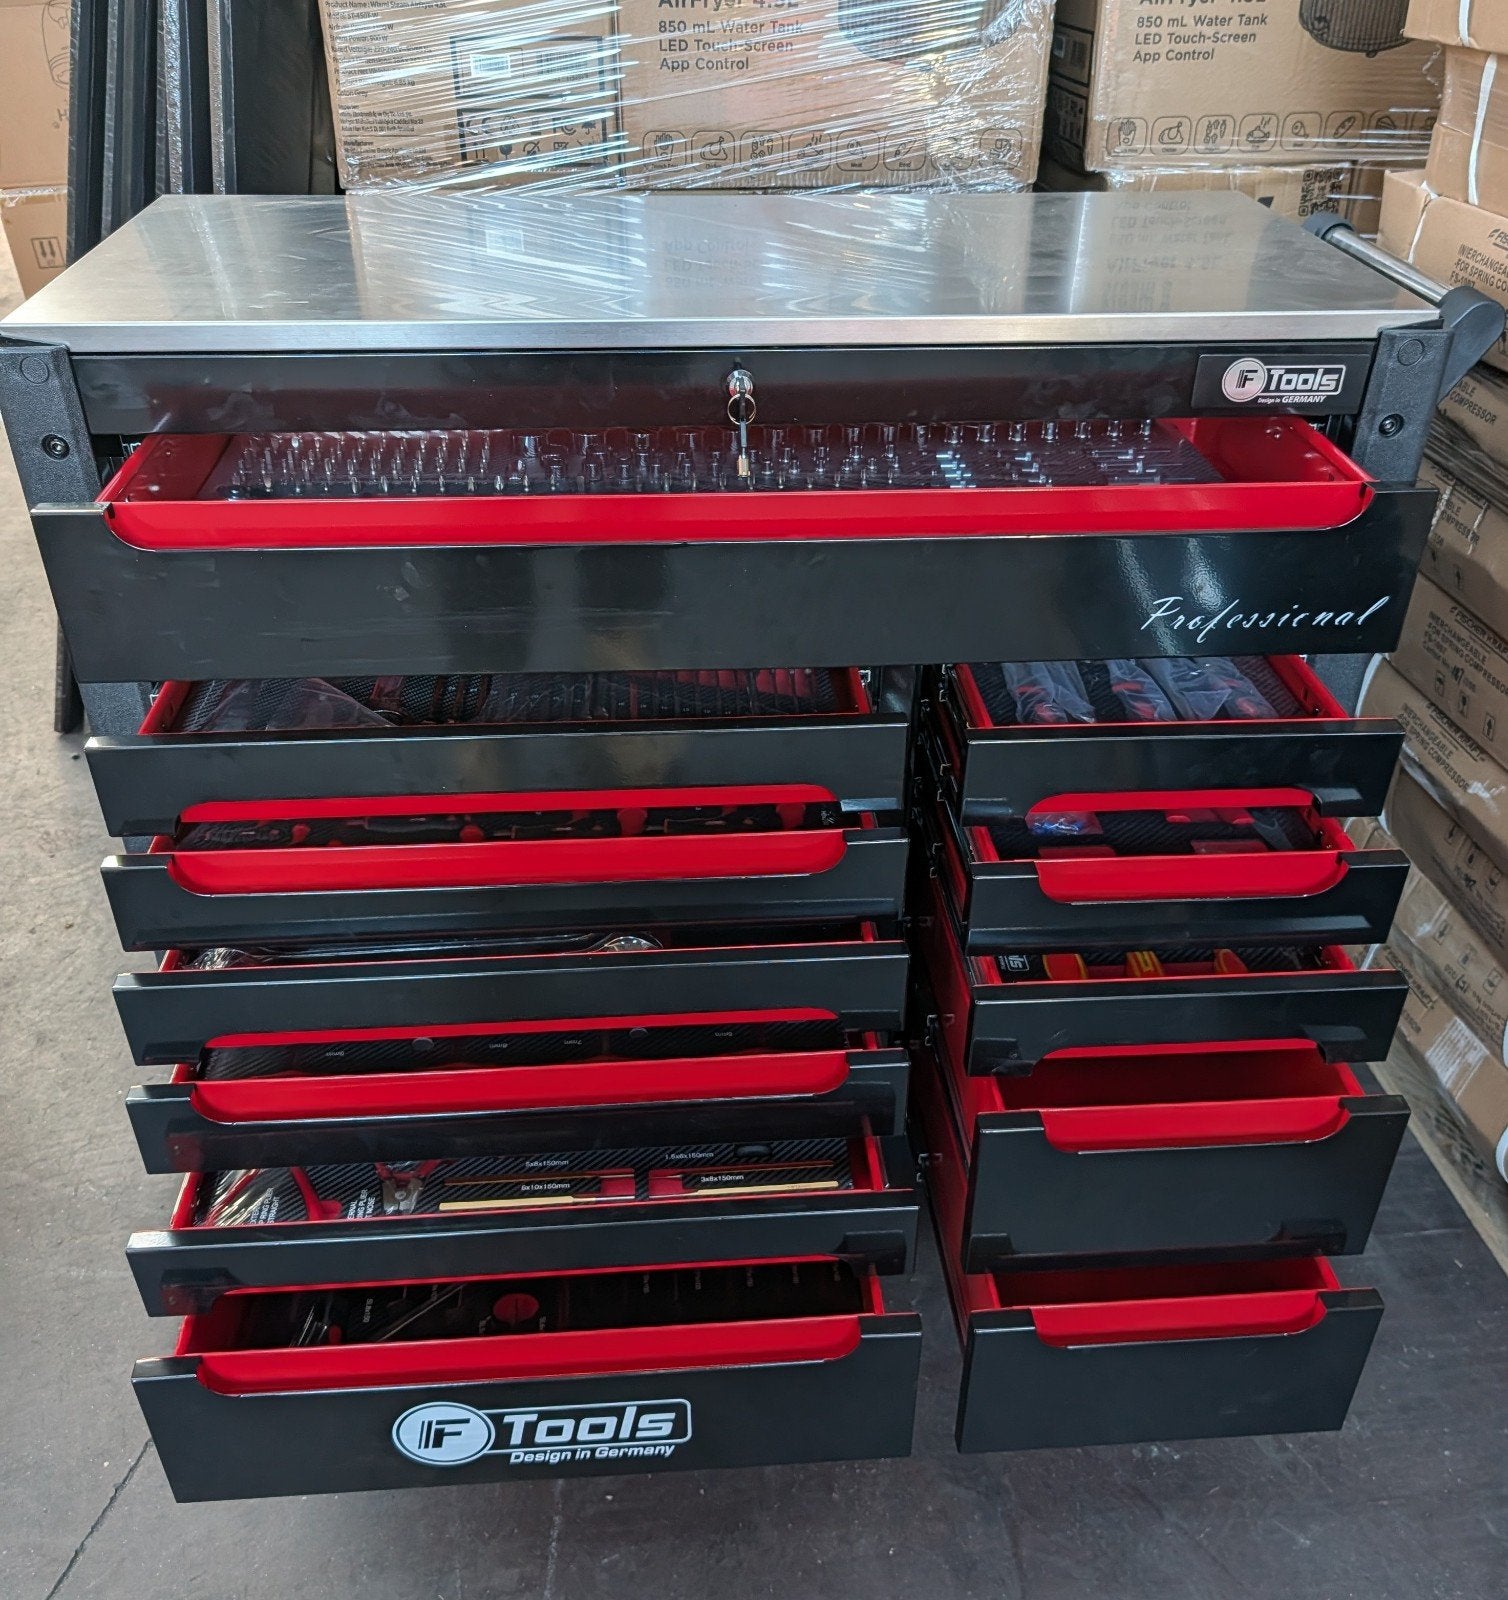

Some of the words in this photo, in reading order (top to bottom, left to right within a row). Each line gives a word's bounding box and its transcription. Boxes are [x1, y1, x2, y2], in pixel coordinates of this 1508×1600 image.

[658, 20, 687, 33] 850
[692, 20, 715, 33] mL
[720, 20, 765, 33] Water
[770, 20, 803, 33] Tank
[1137, 15, 1162, 28] 850
[1167, 15, 1187, 28] mL
[1193, 14, 1233, 27] Water
[1238, 13, 1268, 26] Tank
[659, 39, 688, 52] LED
[693, 39, 793, 52] Touch-Screen
[1135, 33, 1162, 45] LED
[1167, 31, 1257, 45] Touch-Screen
[659, 57, 690, 72] App
[695, 56, 749, 70] Control
[1132, 50, 1160, 64] App
[1165, 48, 1215, 62] Control
[1469, 265, 1494, 287] SPRING
[1269, 368, 1340, 391] Tools
[1257, 396, 1275, 404] Design
[1282, 395, 1327, 403] GERMANY
[1140, 595, 1392, 644] Professional
[502, 1406, 676, 1446] Tools
[509, 1449, 571, 1466] Design
[576, 1448, 591, 1461] in
[595, 1444, 675, 1460] Germany
